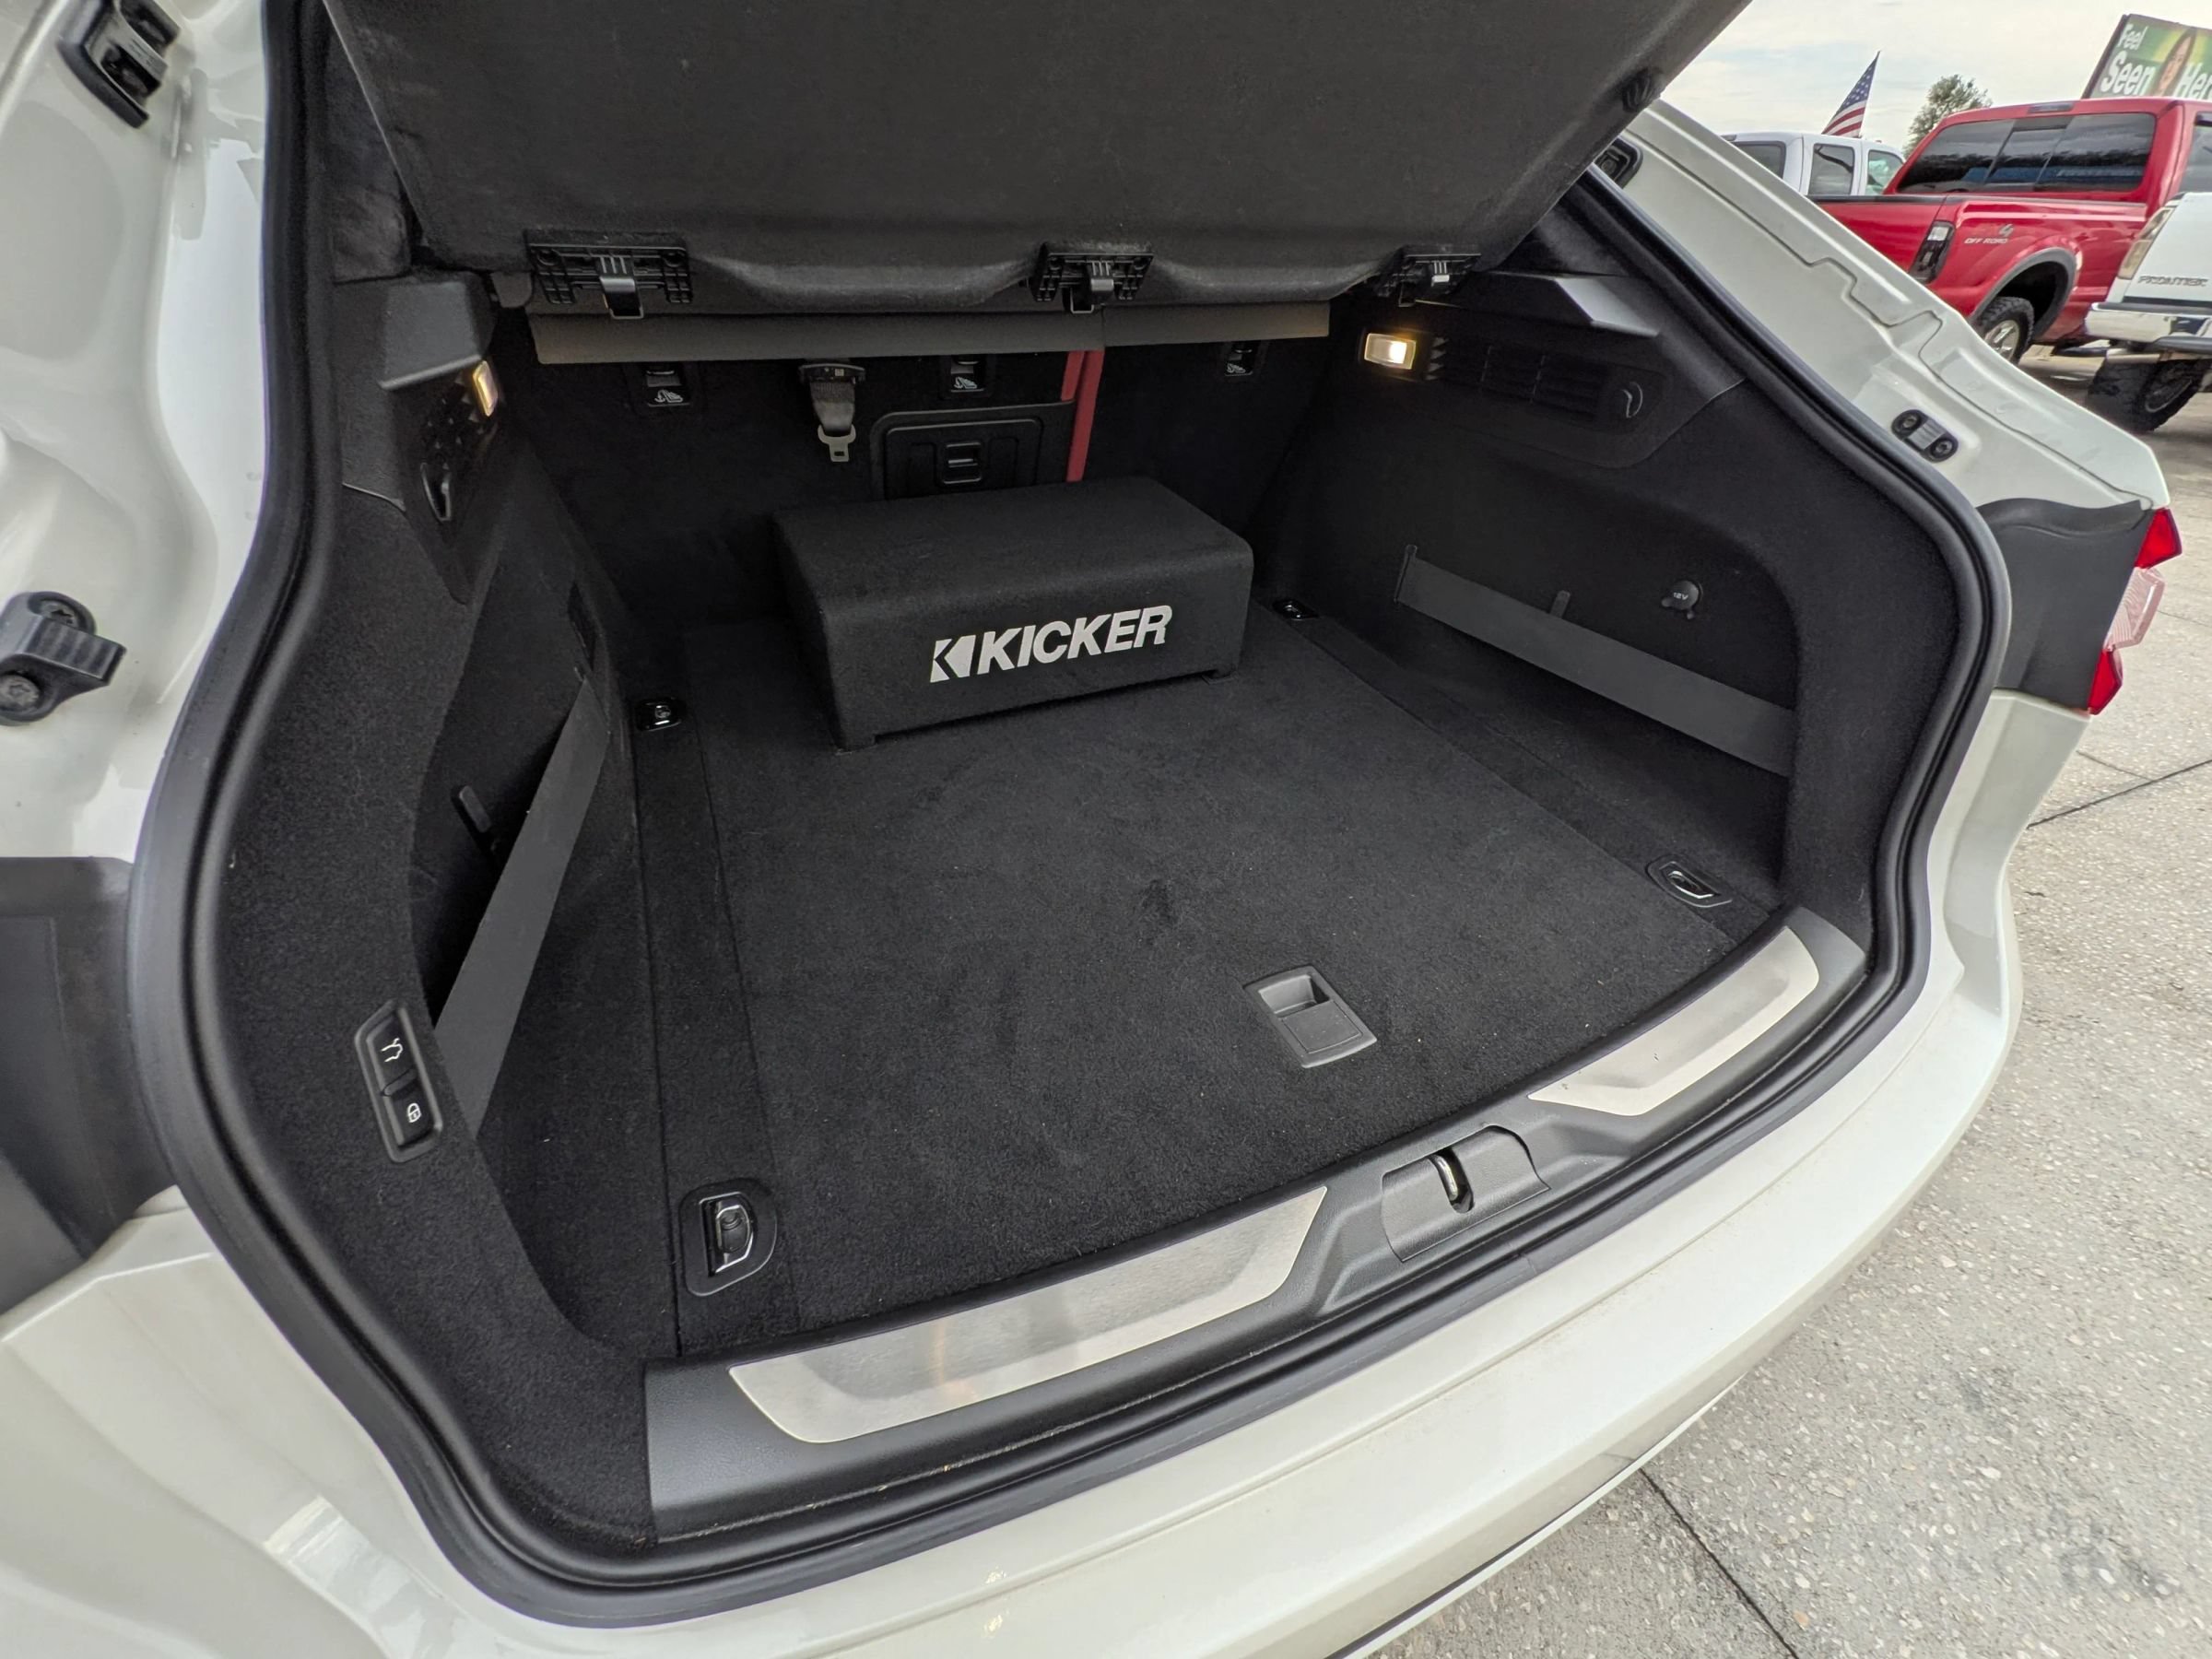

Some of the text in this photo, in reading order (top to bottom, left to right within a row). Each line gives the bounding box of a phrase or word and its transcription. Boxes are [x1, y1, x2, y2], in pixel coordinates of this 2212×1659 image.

[2118, 23, 2148, 50] Feel
[2100, 50, 2212, 101] Seen Her
[976, 605, 1173, 676] KICKER
